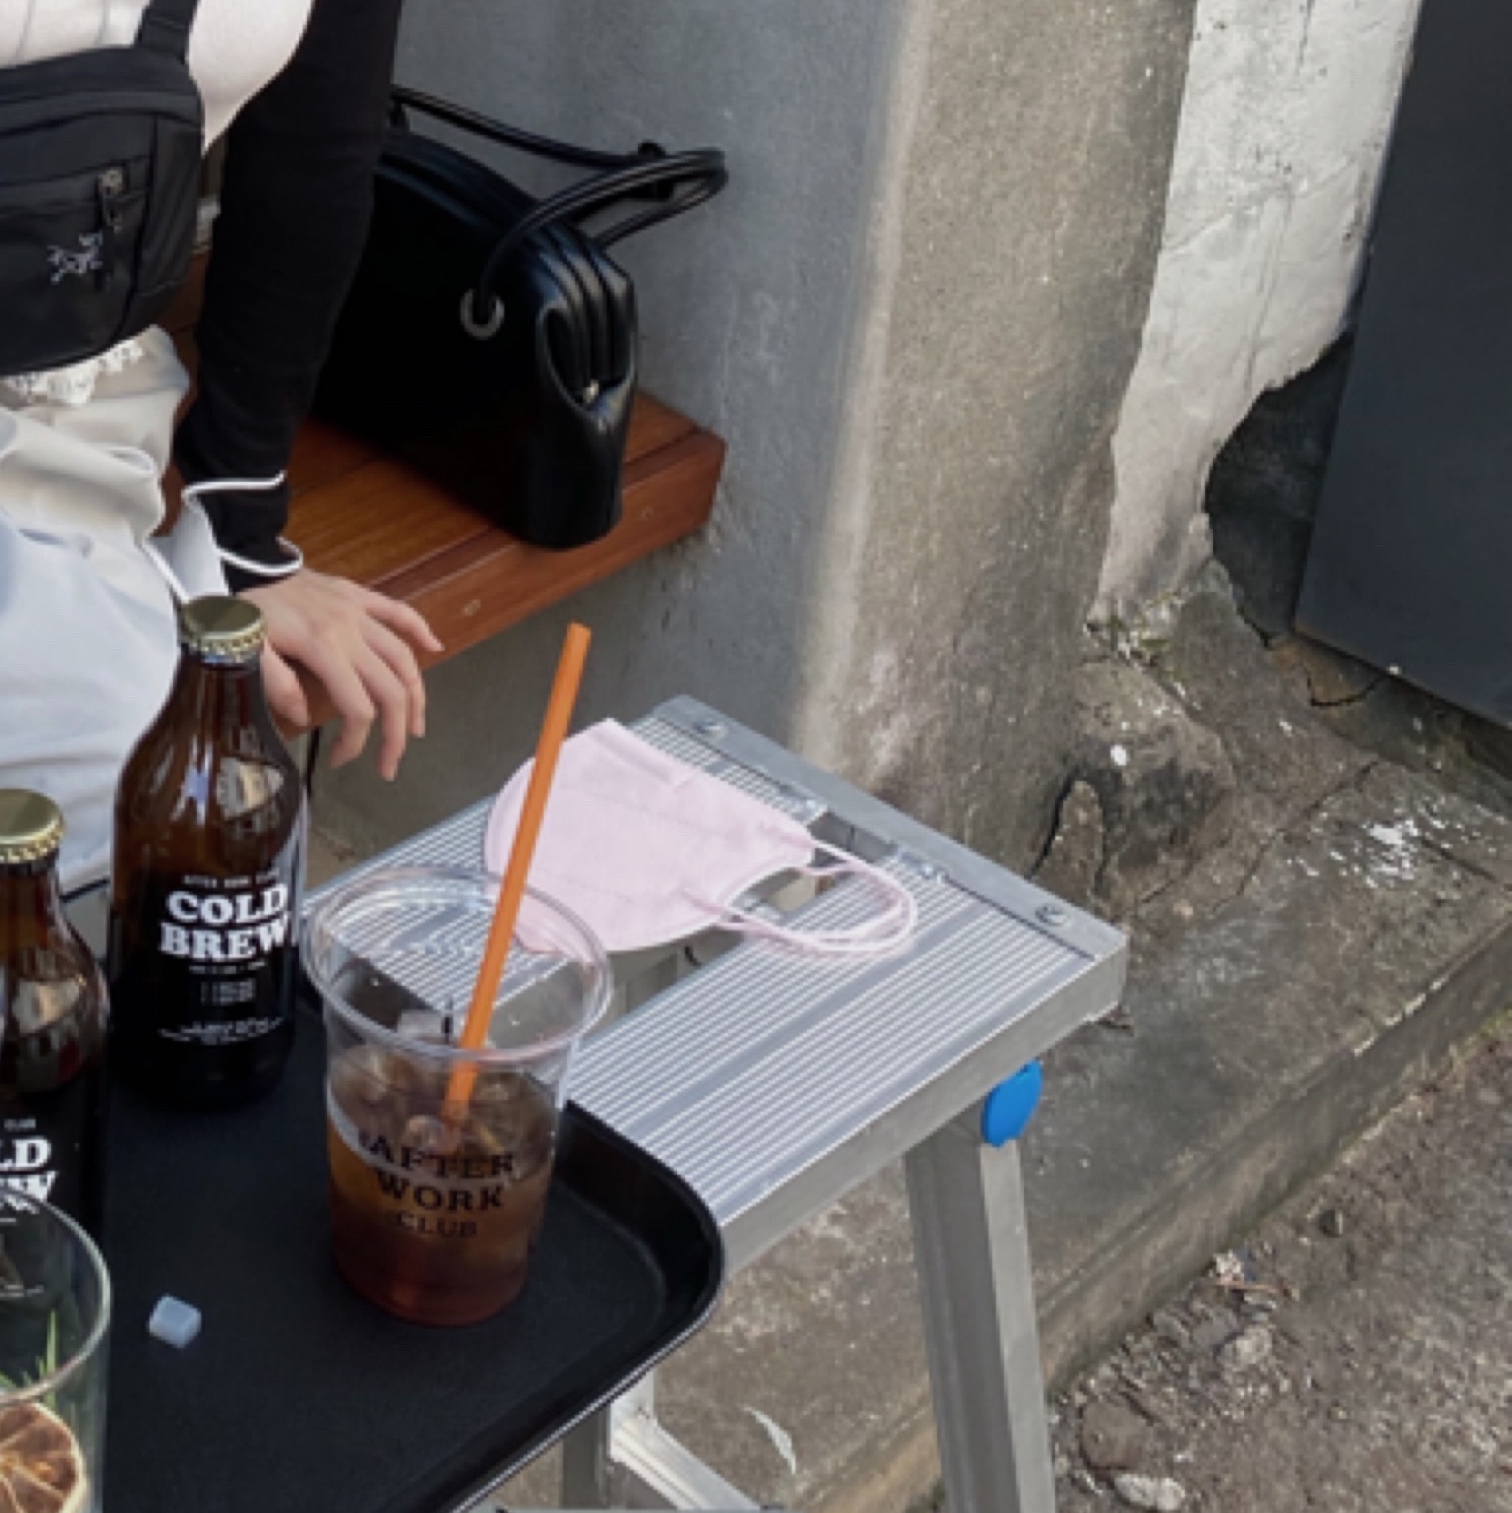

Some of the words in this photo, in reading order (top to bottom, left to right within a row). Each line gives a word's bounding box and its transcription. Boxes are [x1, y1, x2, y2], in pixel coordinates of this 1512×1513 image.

[167, 883, 289, 925] COLD
[159, 910, 290, 961] BREW
[366, 1134, 514, 1180] AFTER
[376, 1169, 505, 1211] WORK
[393, 1209, 479, 1240] CLUB
